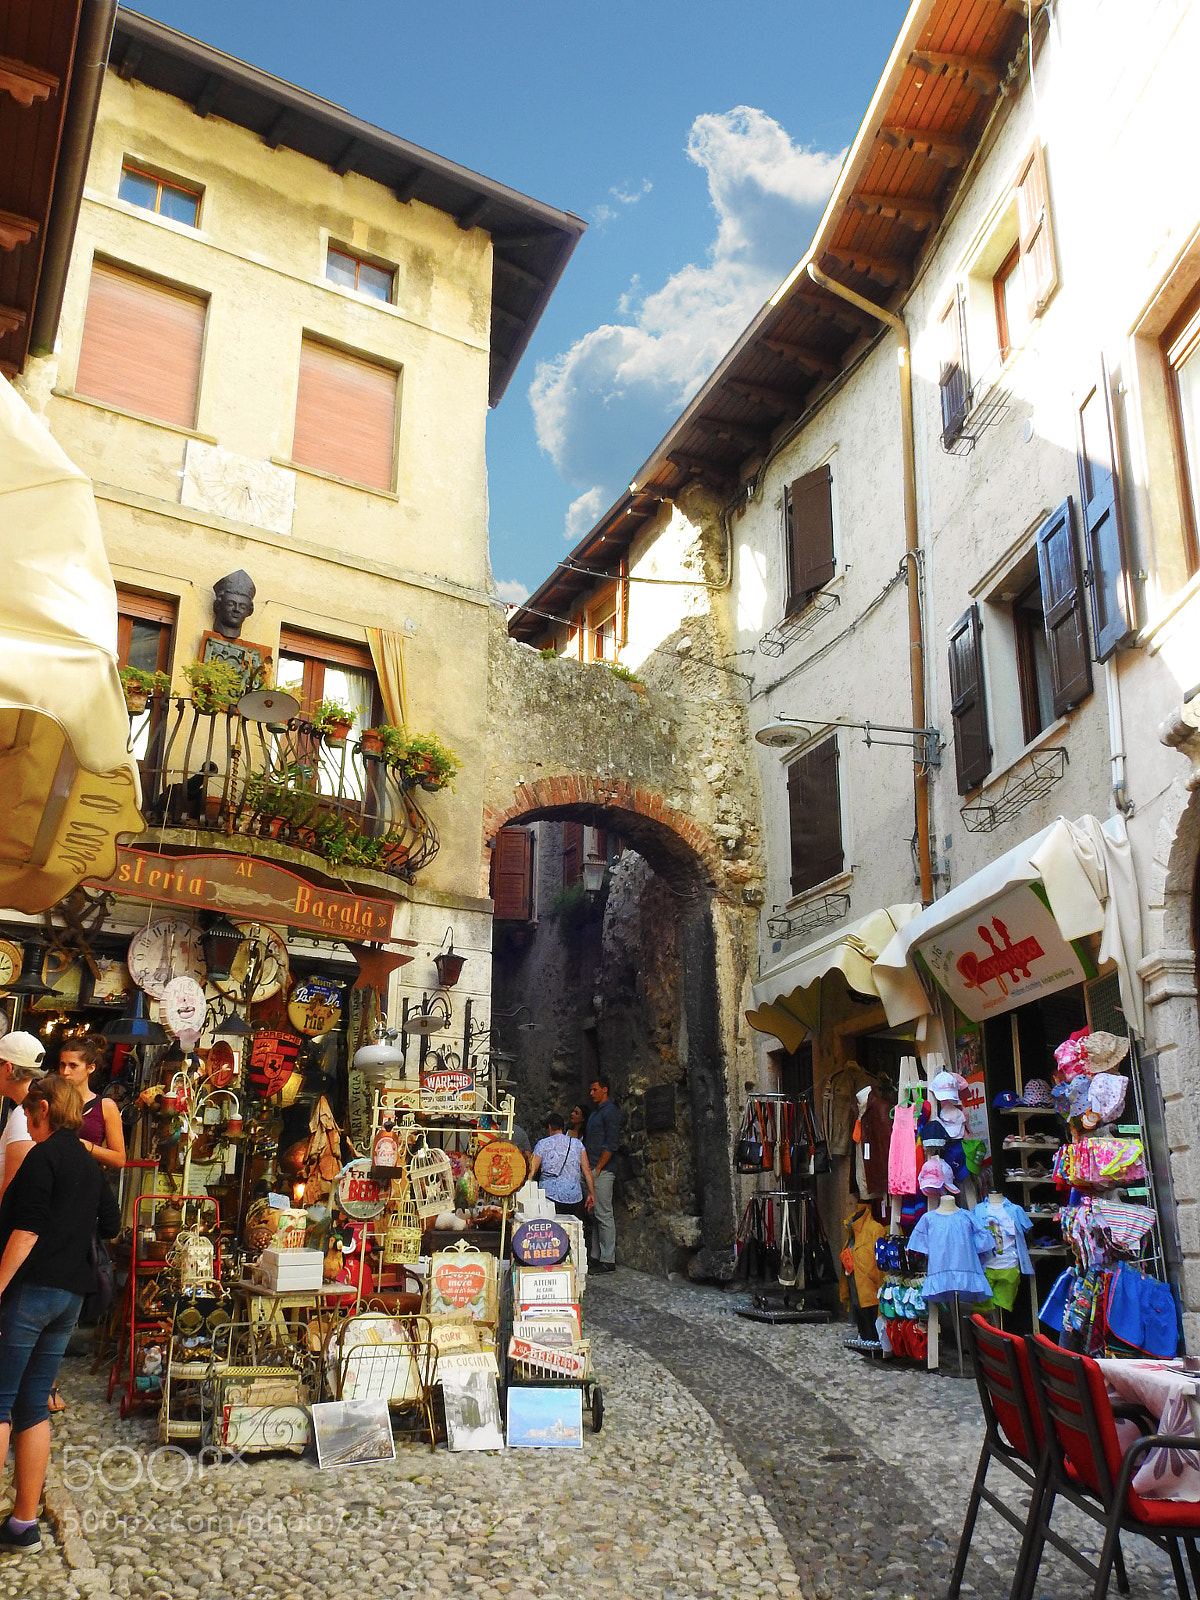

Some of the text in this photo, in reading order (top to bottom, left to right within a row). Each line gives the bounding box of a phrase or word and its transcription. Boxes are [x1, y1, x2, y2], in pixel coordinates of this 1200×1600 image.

[118, 856, 204, 896] steria
[235, 861, 253, 878] Al
[256, 1031, 303, 1046] PORSCHE
[427, 1074, 469, 1089] WARNING
[348, 1179, 380, 1203] BEER
[528, 1223, 552, 1232] KEEP
[525, 1231, 553, 1239] CALM
[529, 1242, 553, 1250] HAVE
[523, 1249, 560, 1259] A BEER
[533, 1278, 557, 1287] ATTENTI
[440, 1331, 461, 1343] CORN
[456, 1354, 490, 1368] CUCINA
